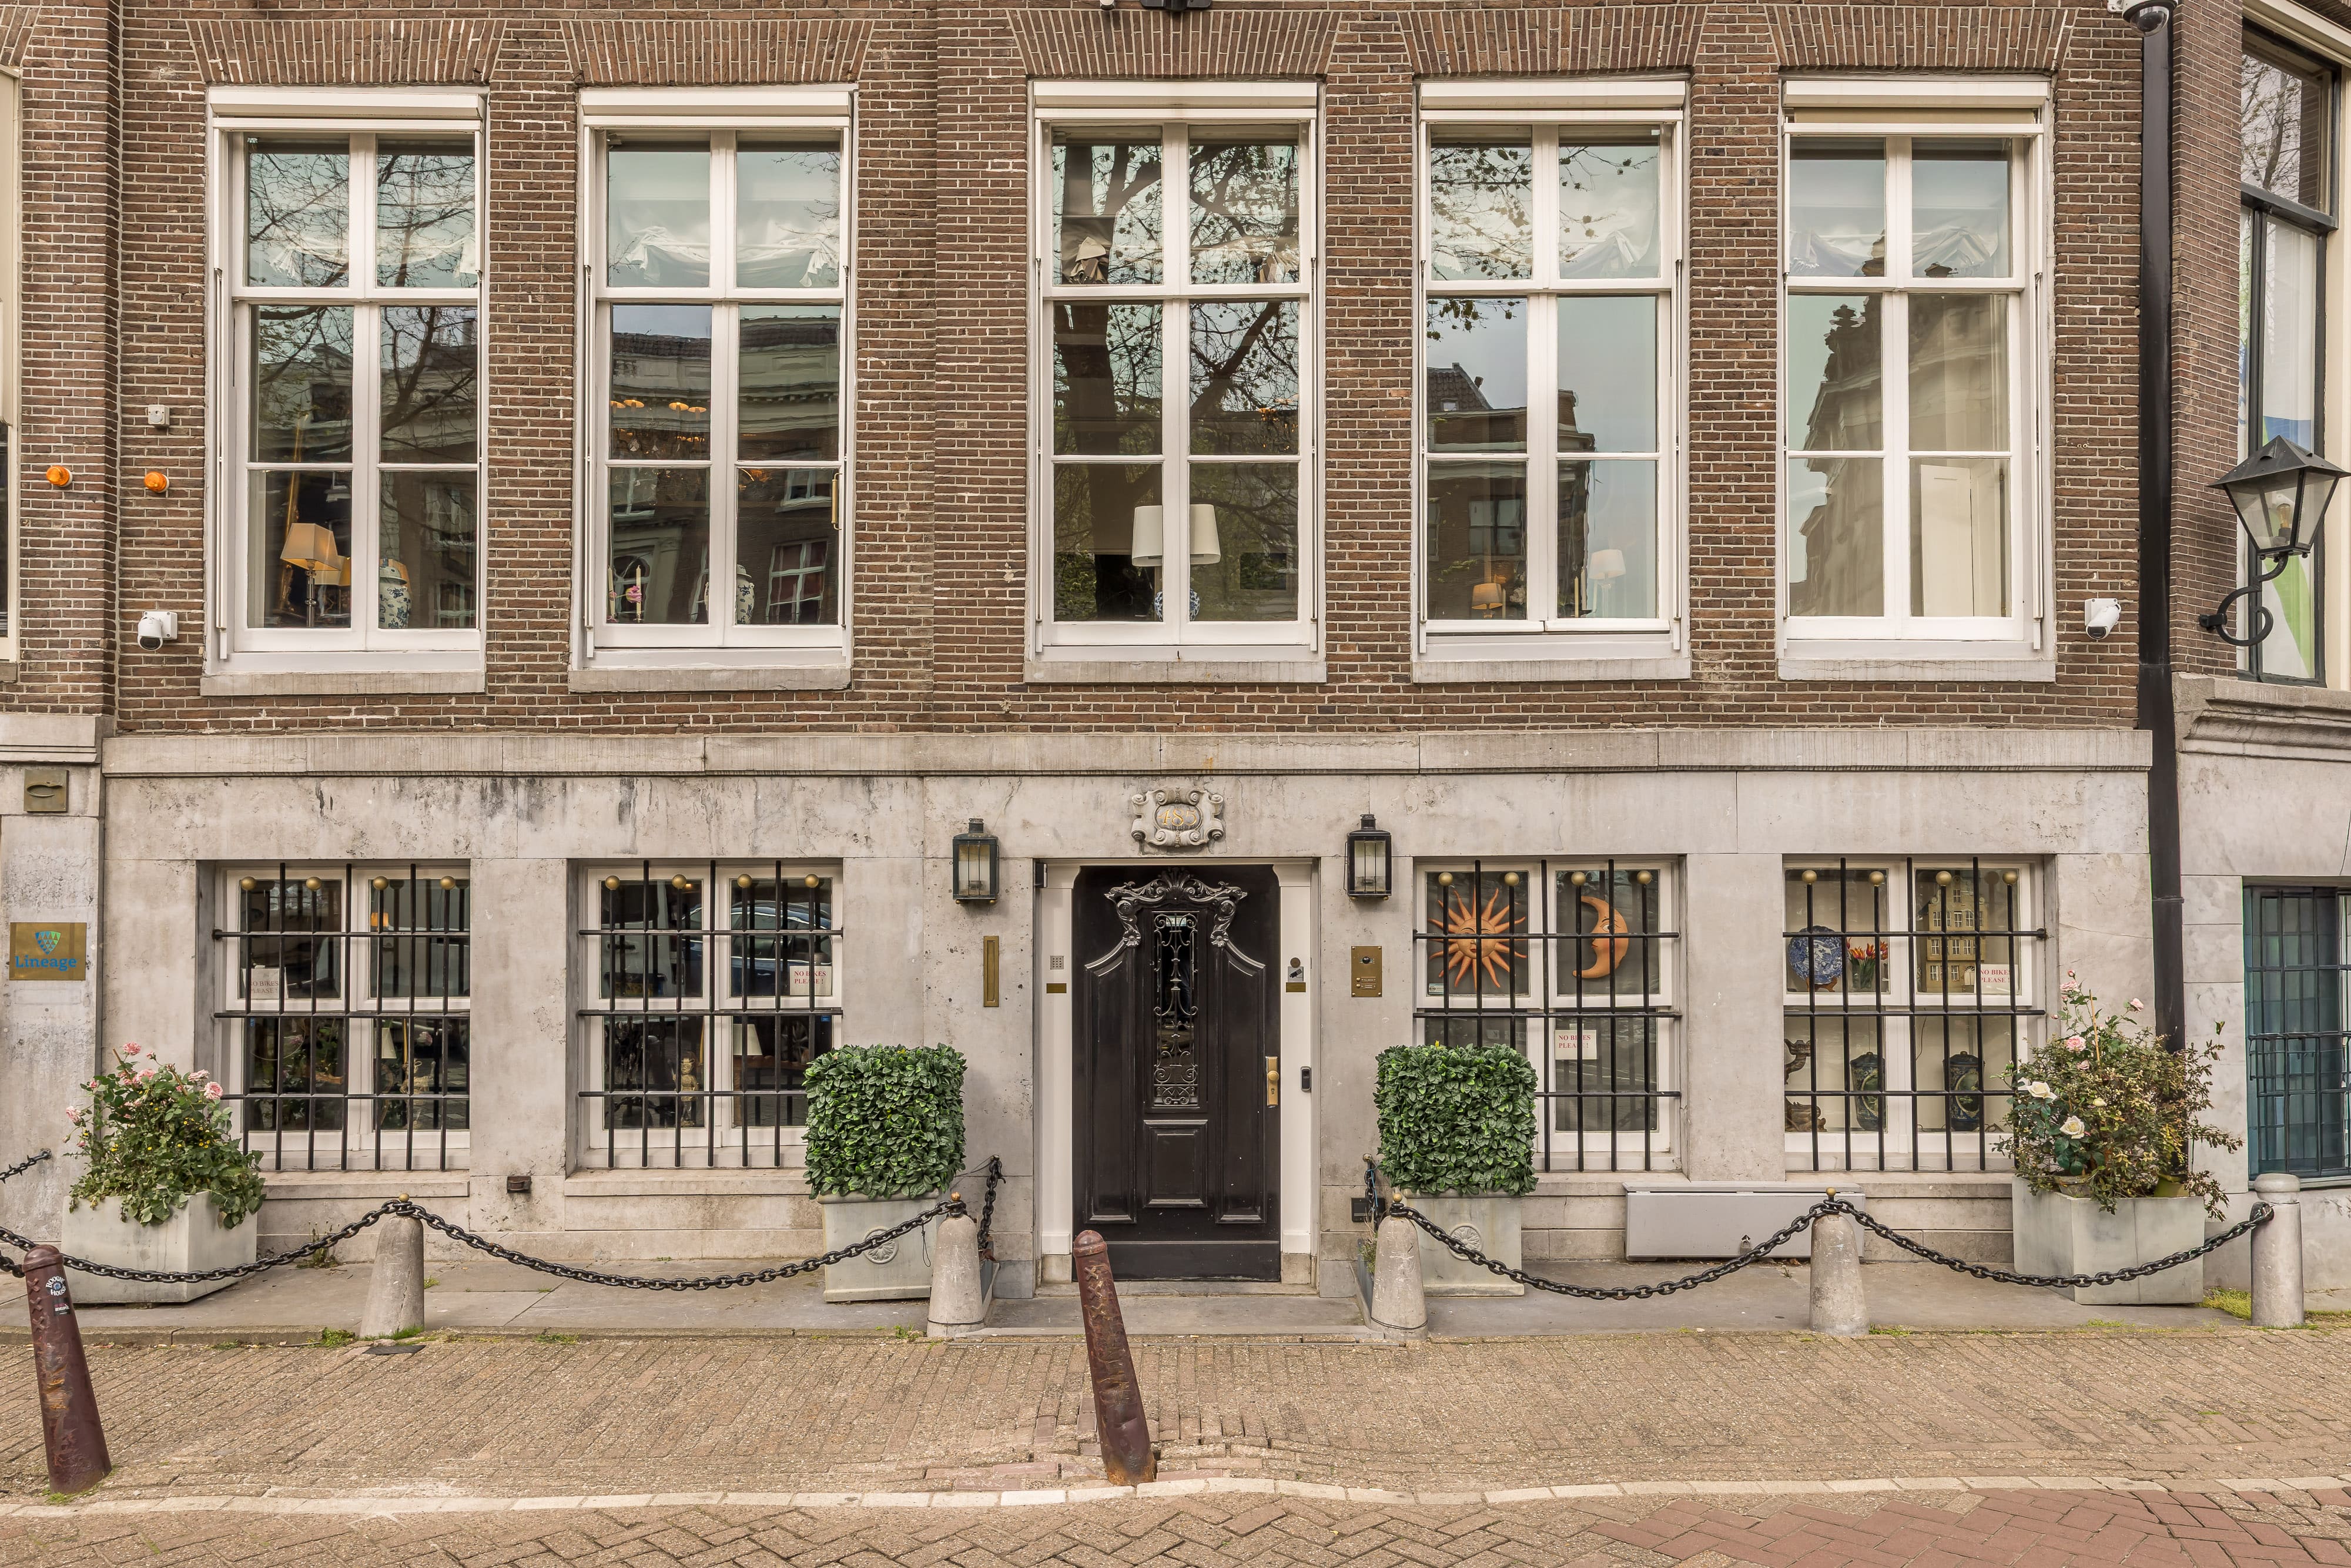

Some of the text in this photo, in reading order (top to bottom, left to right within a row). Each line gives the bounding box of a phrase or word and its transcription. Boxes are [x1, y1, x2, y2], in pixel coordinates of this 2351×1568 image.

[1158, 808, 1197, 827] 485
[15, 954, 77, 971] Lineage
[46, 1276, 65, 1288] BOOGIE
[51, 1284, 66, 1296] HOUSE
